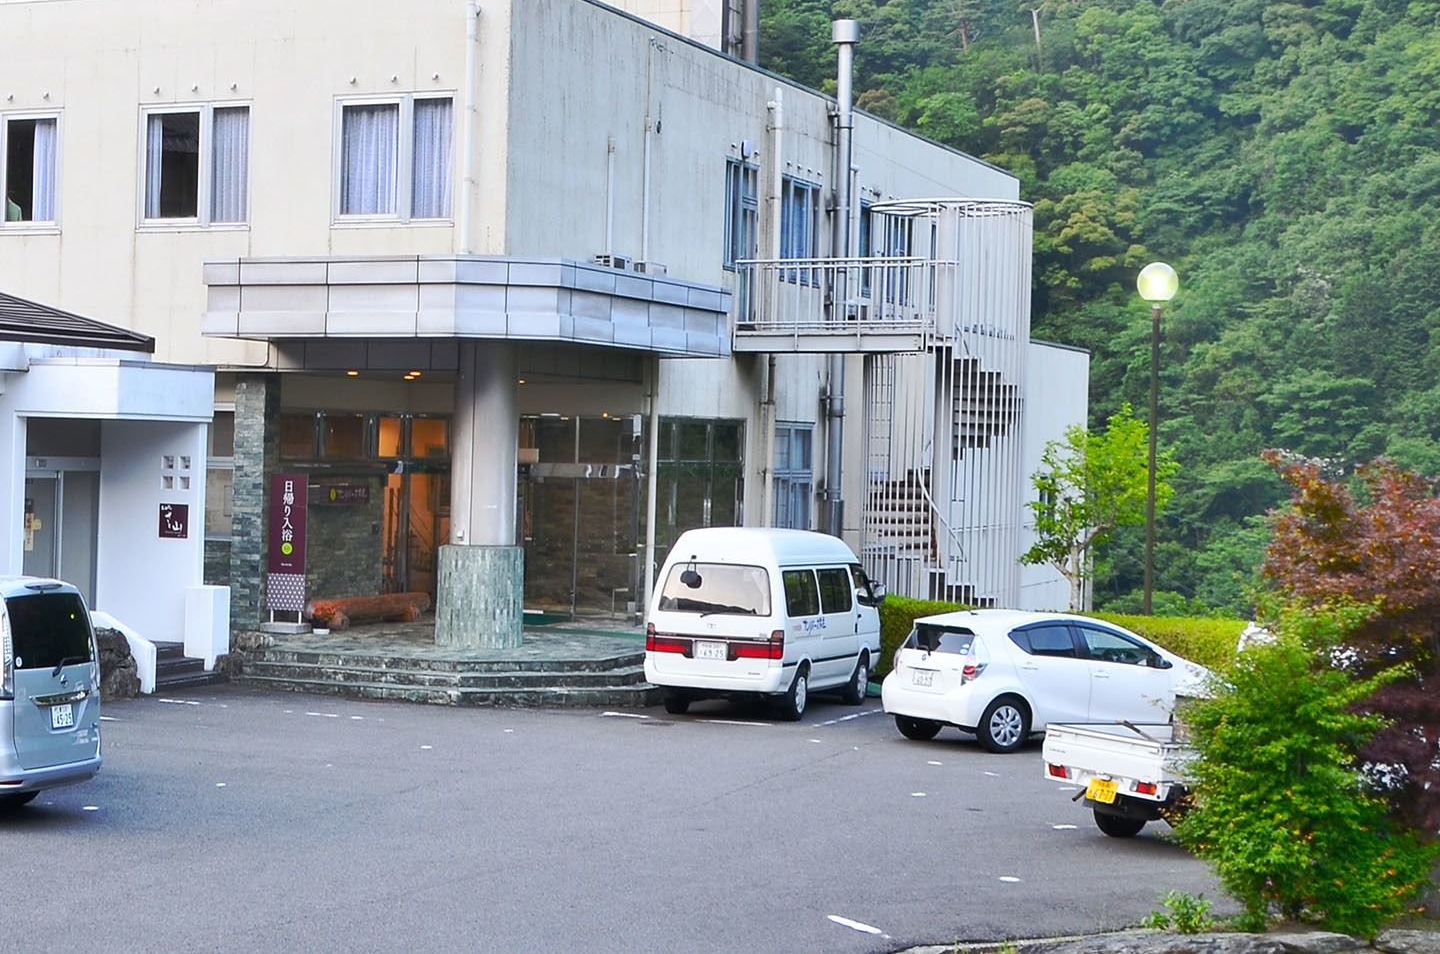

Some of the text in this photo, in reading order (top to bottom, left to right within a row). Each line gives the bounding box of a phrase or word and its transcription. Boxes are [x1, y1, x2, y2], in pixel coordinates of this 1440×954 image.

[281, 480, 295, 542] 日帰り入浴
